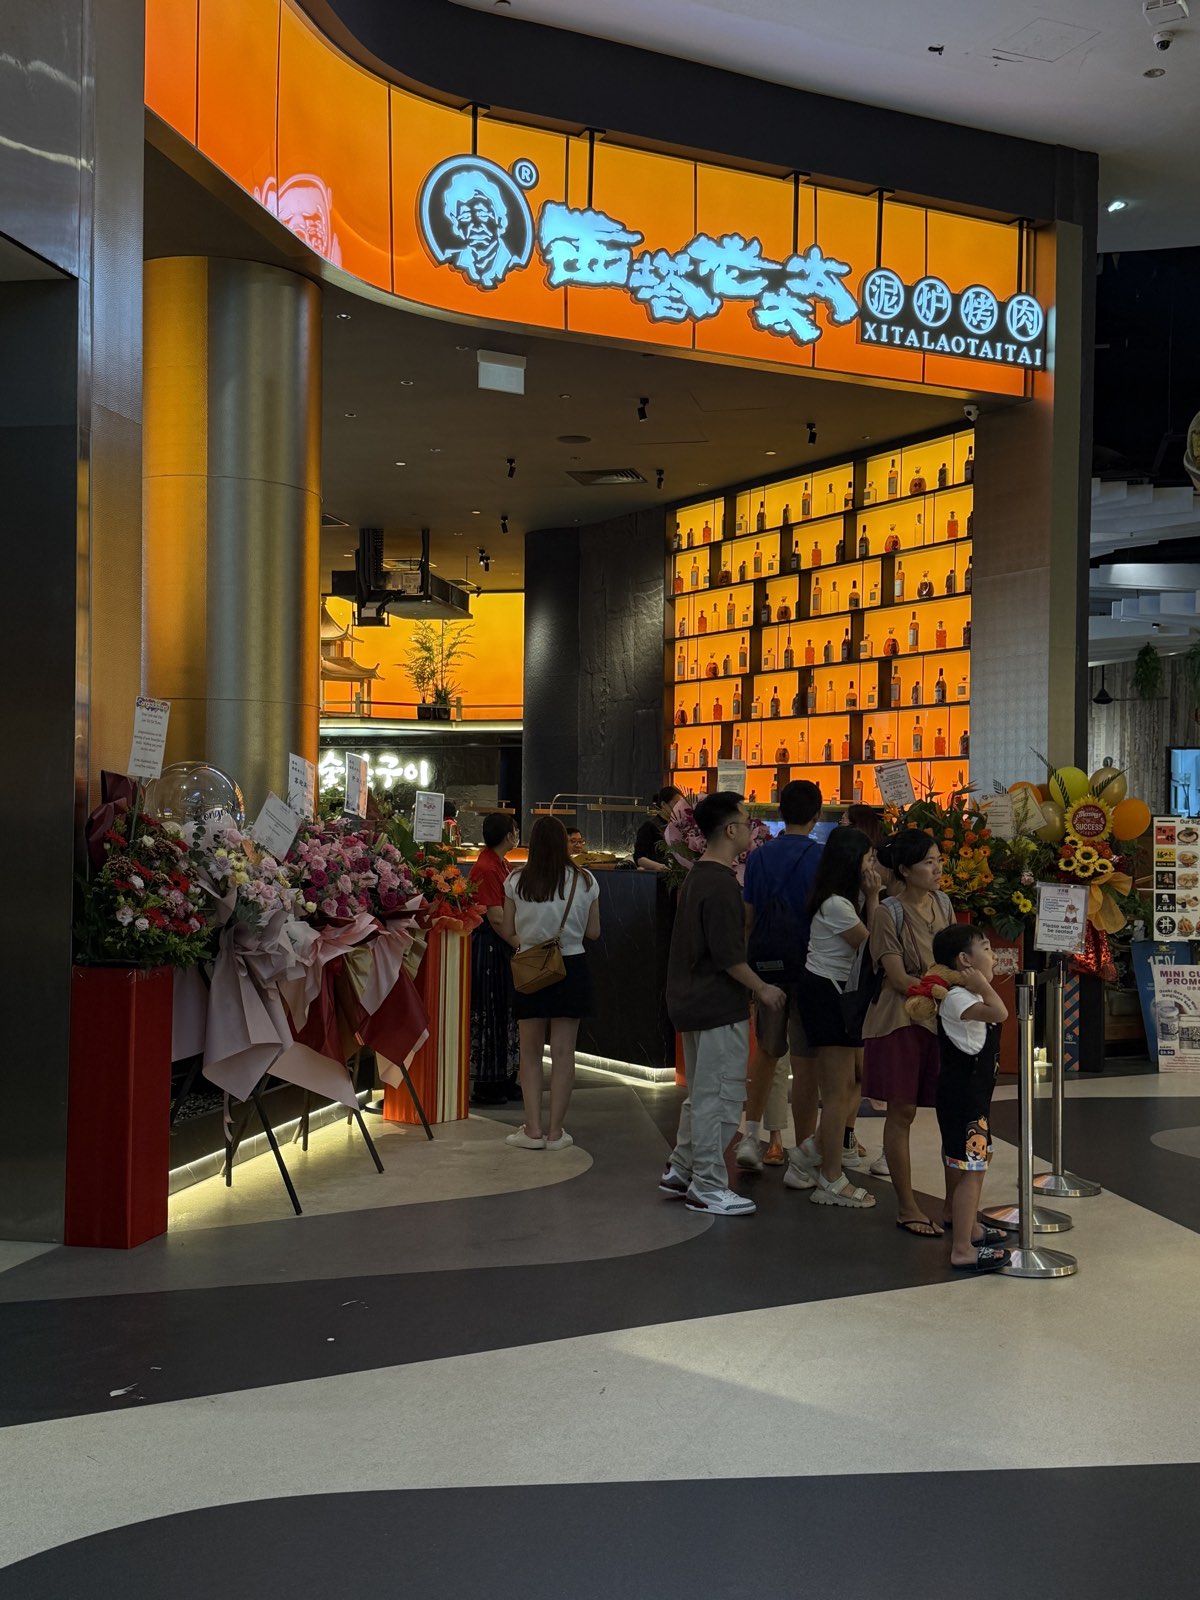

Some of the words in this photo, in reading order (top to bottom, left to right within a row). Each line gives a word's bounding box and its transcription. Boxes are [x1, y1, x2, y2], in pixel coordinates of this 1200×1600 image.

[866, 271, 1043, 341] 泥炉烤肉
[863, 321, 1042, 366] XITALAOTAITAI
[1075, 823, 1103, 831] SUCCESS
[1160, 970, 1185, 978] MINI
[1166, 978, 1200, 986] PROM
